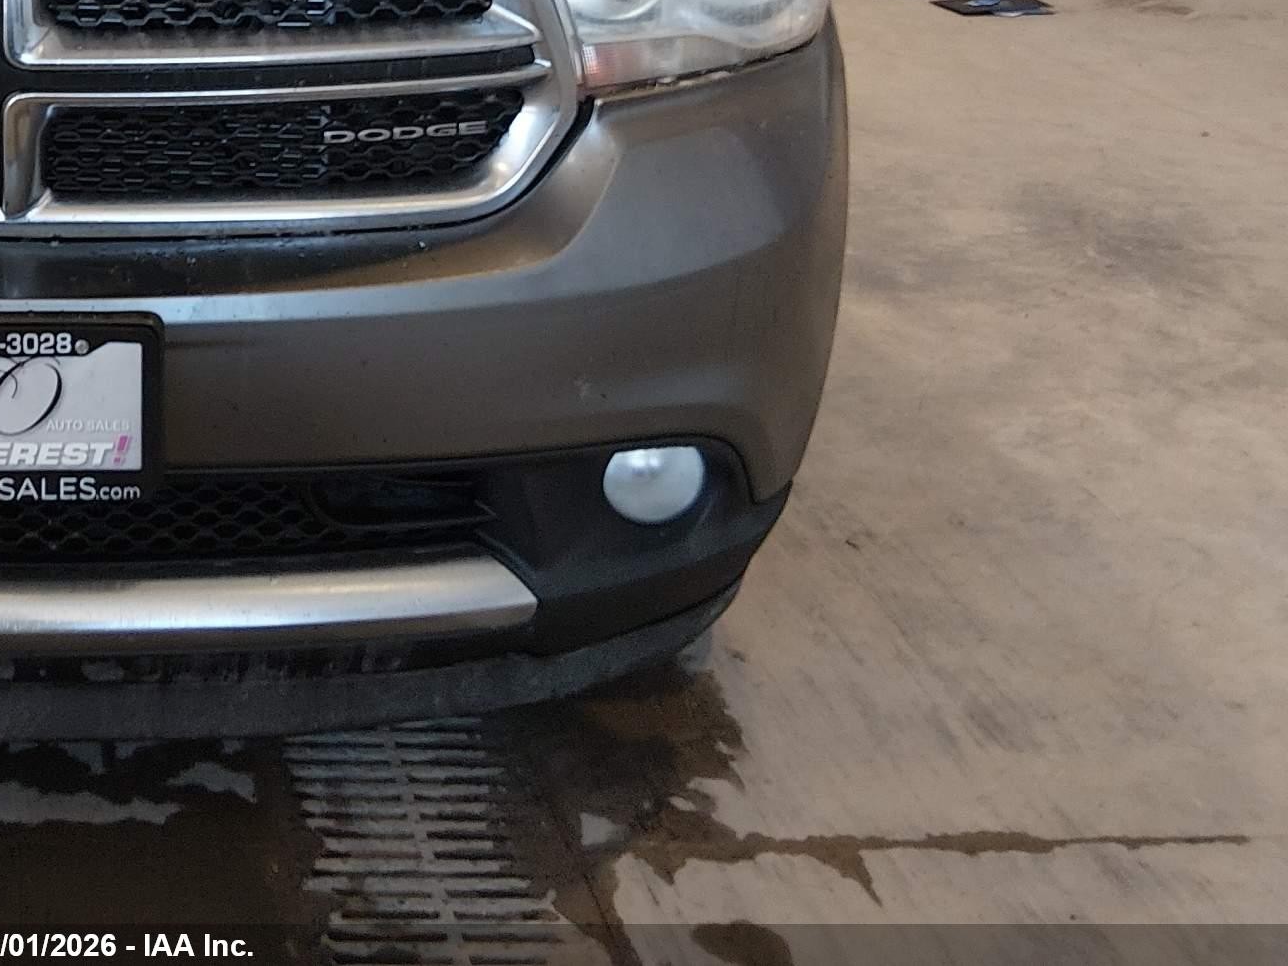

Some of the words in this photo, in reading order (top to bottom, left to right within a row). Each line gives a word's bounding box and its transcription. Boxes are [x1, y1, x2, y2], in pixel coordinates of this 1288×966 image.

[323, 120, 488, 144] DODGE
[46, 418, 83, 432] AUTO
[87, 419, 130, 432] SALES
